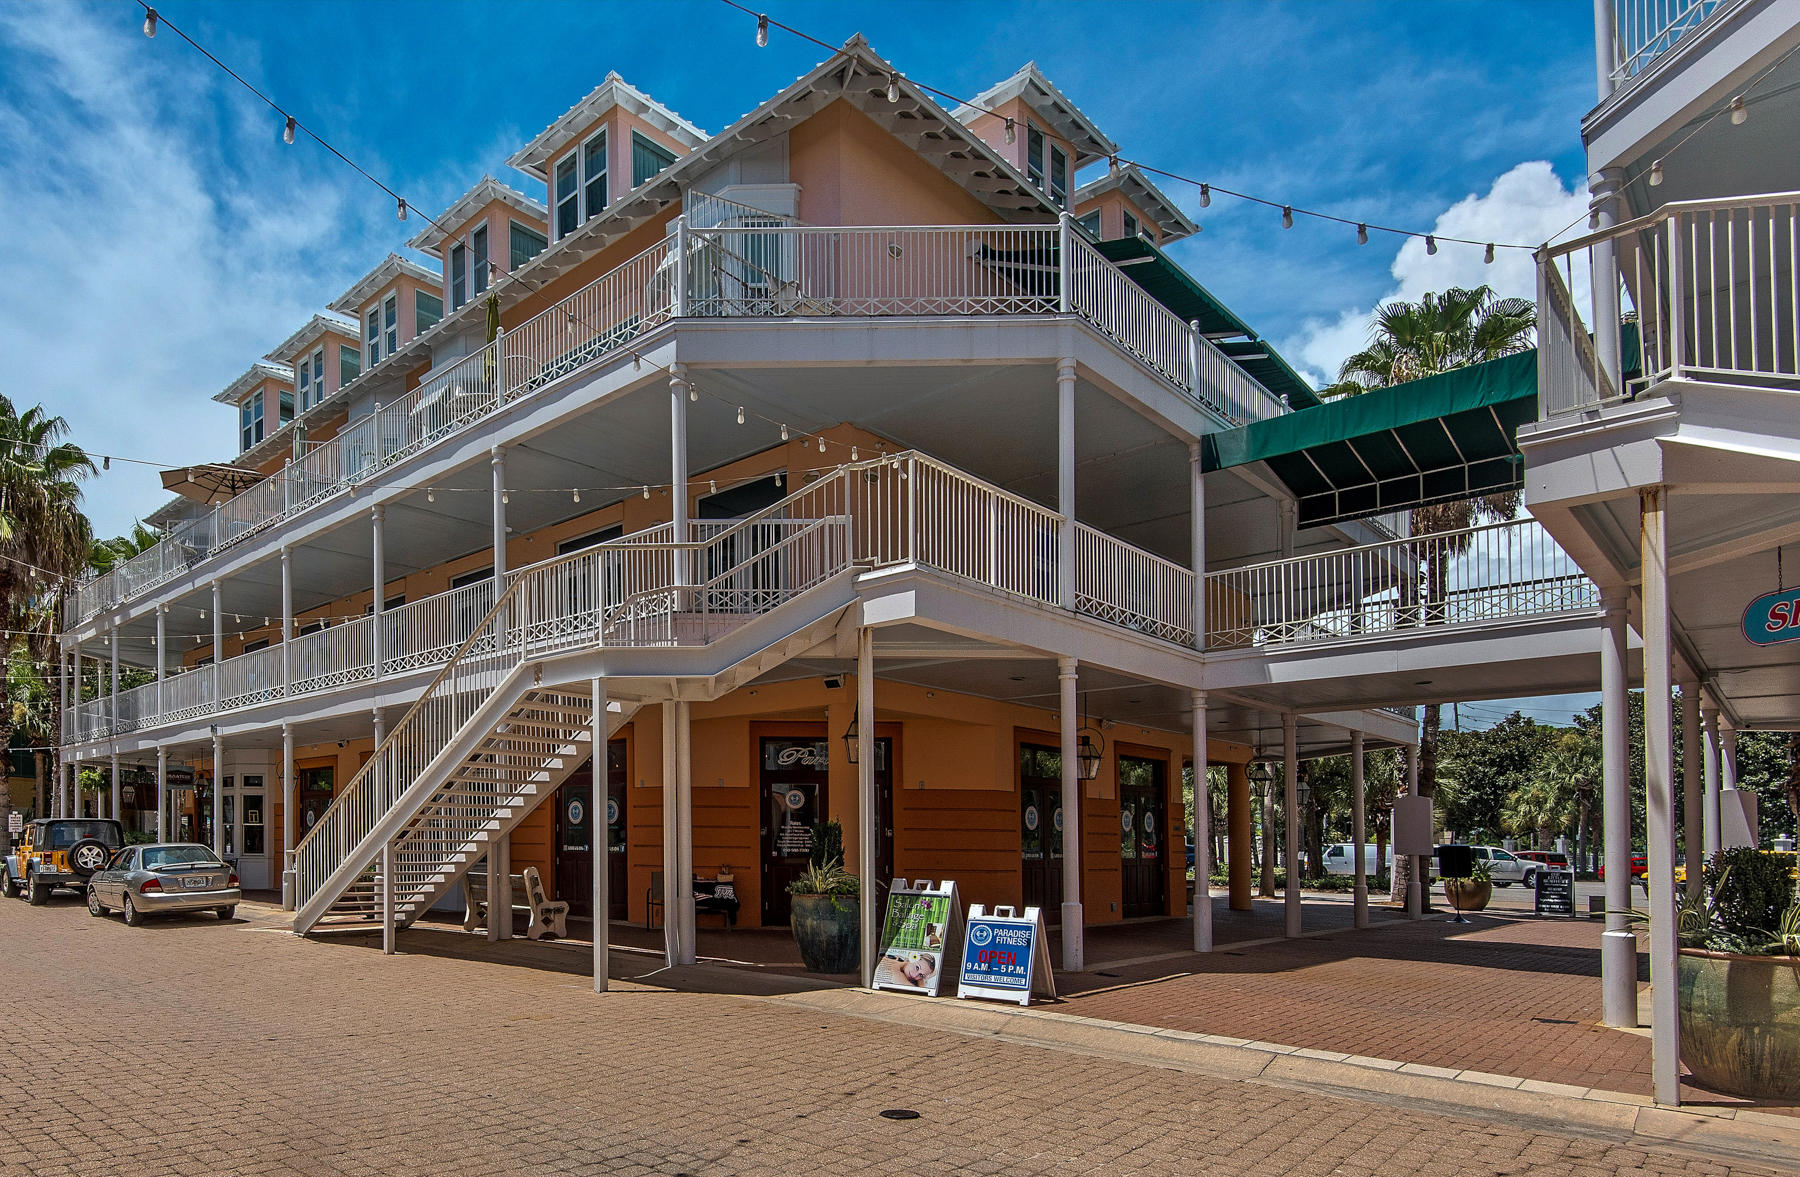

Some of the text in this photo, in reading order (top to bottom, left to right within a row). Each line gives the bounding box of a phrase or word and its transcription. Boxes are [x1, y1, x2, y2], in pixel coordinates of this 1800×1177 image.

[893, 897, 920, 909] Salon
[898, 921, 918, 932] Spa
[994, 928, 1031, 938] PARADISE
[996, 937, 1028, 946] FITNESS
[978, 950, 1016, 965] OPEN
[966, 962, 972, 970] 9
[973, 962, 990, 971] A.M.
[1000, 965, 1006, 973] 5
[1008, 965, 1026, 975] P.M.
[993, 975, 1024, 985] WELCOME
